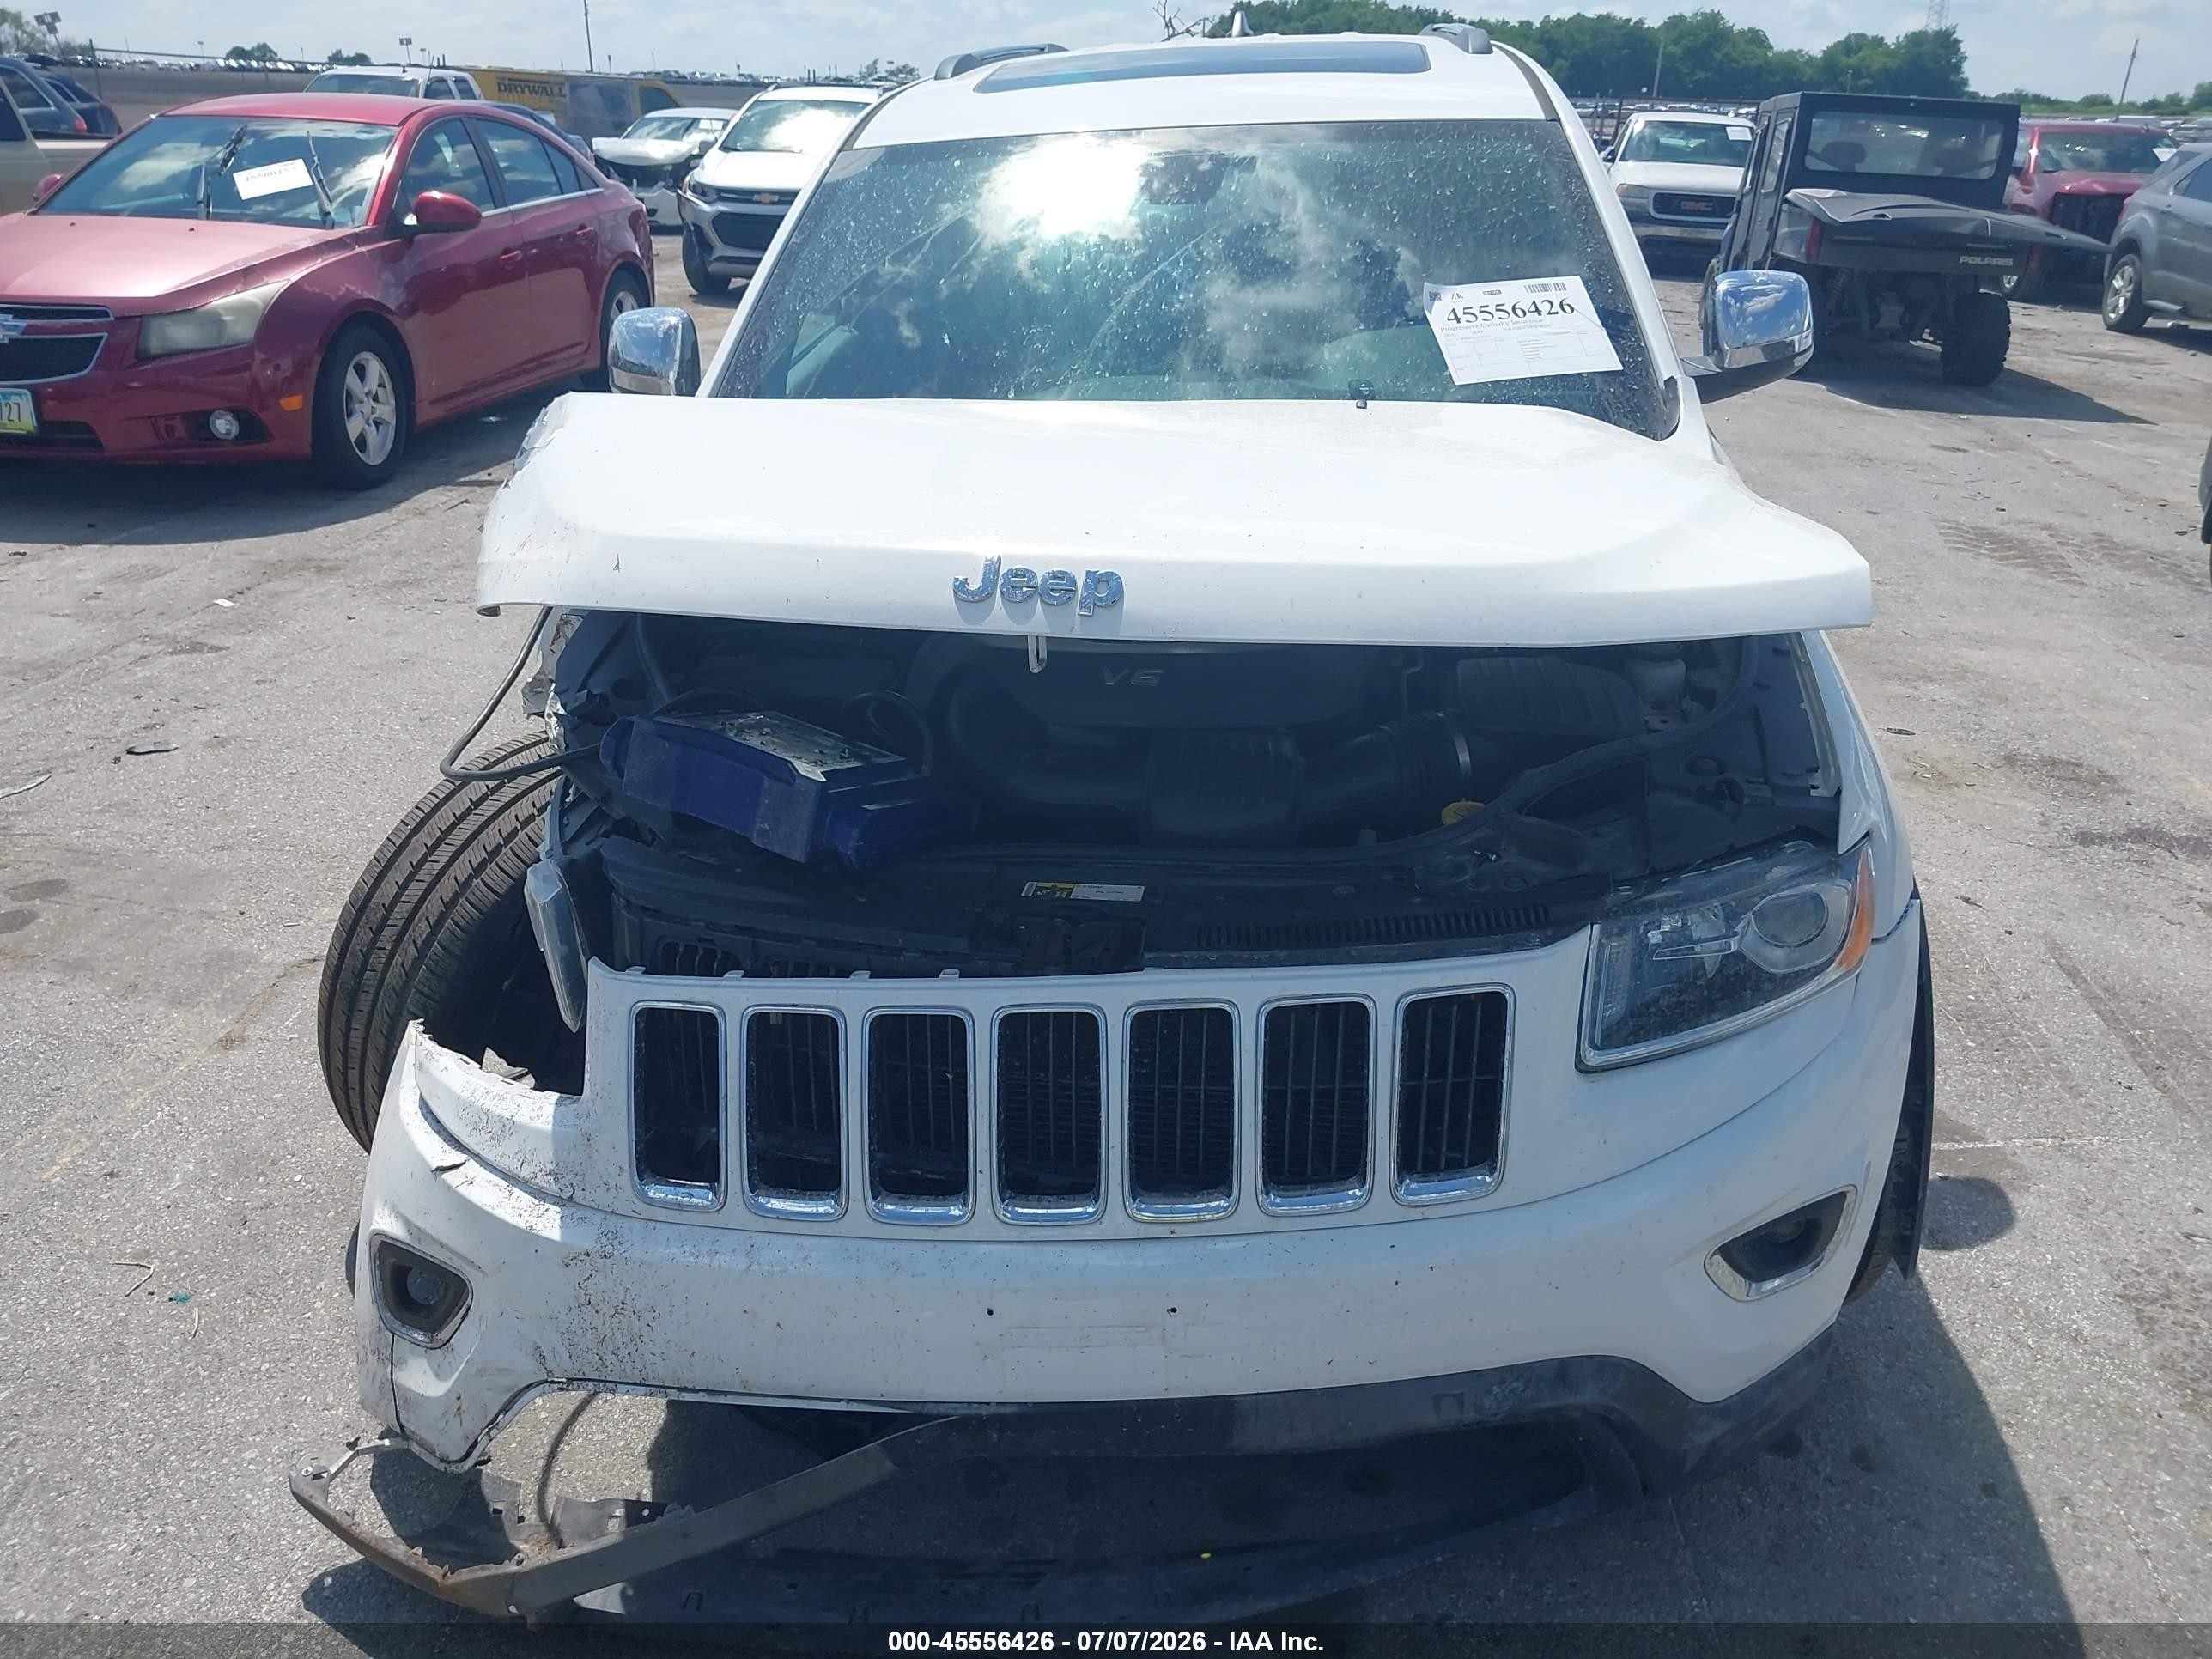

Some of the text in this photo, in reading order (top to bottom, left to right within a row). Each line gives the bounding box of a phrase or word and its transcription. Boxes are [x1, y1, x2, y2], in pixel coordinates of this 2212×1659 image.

[496, 82, 566, 97] DRYWALL
[1680, 201, 1713, 211] GMC
[1959, 256, 2013, 266] POLARIS
[1446, 297, 1575, 324] 45556426
[953, 554, 1124, 617] Jeep
[1102, 666, 1165, 685] V6
